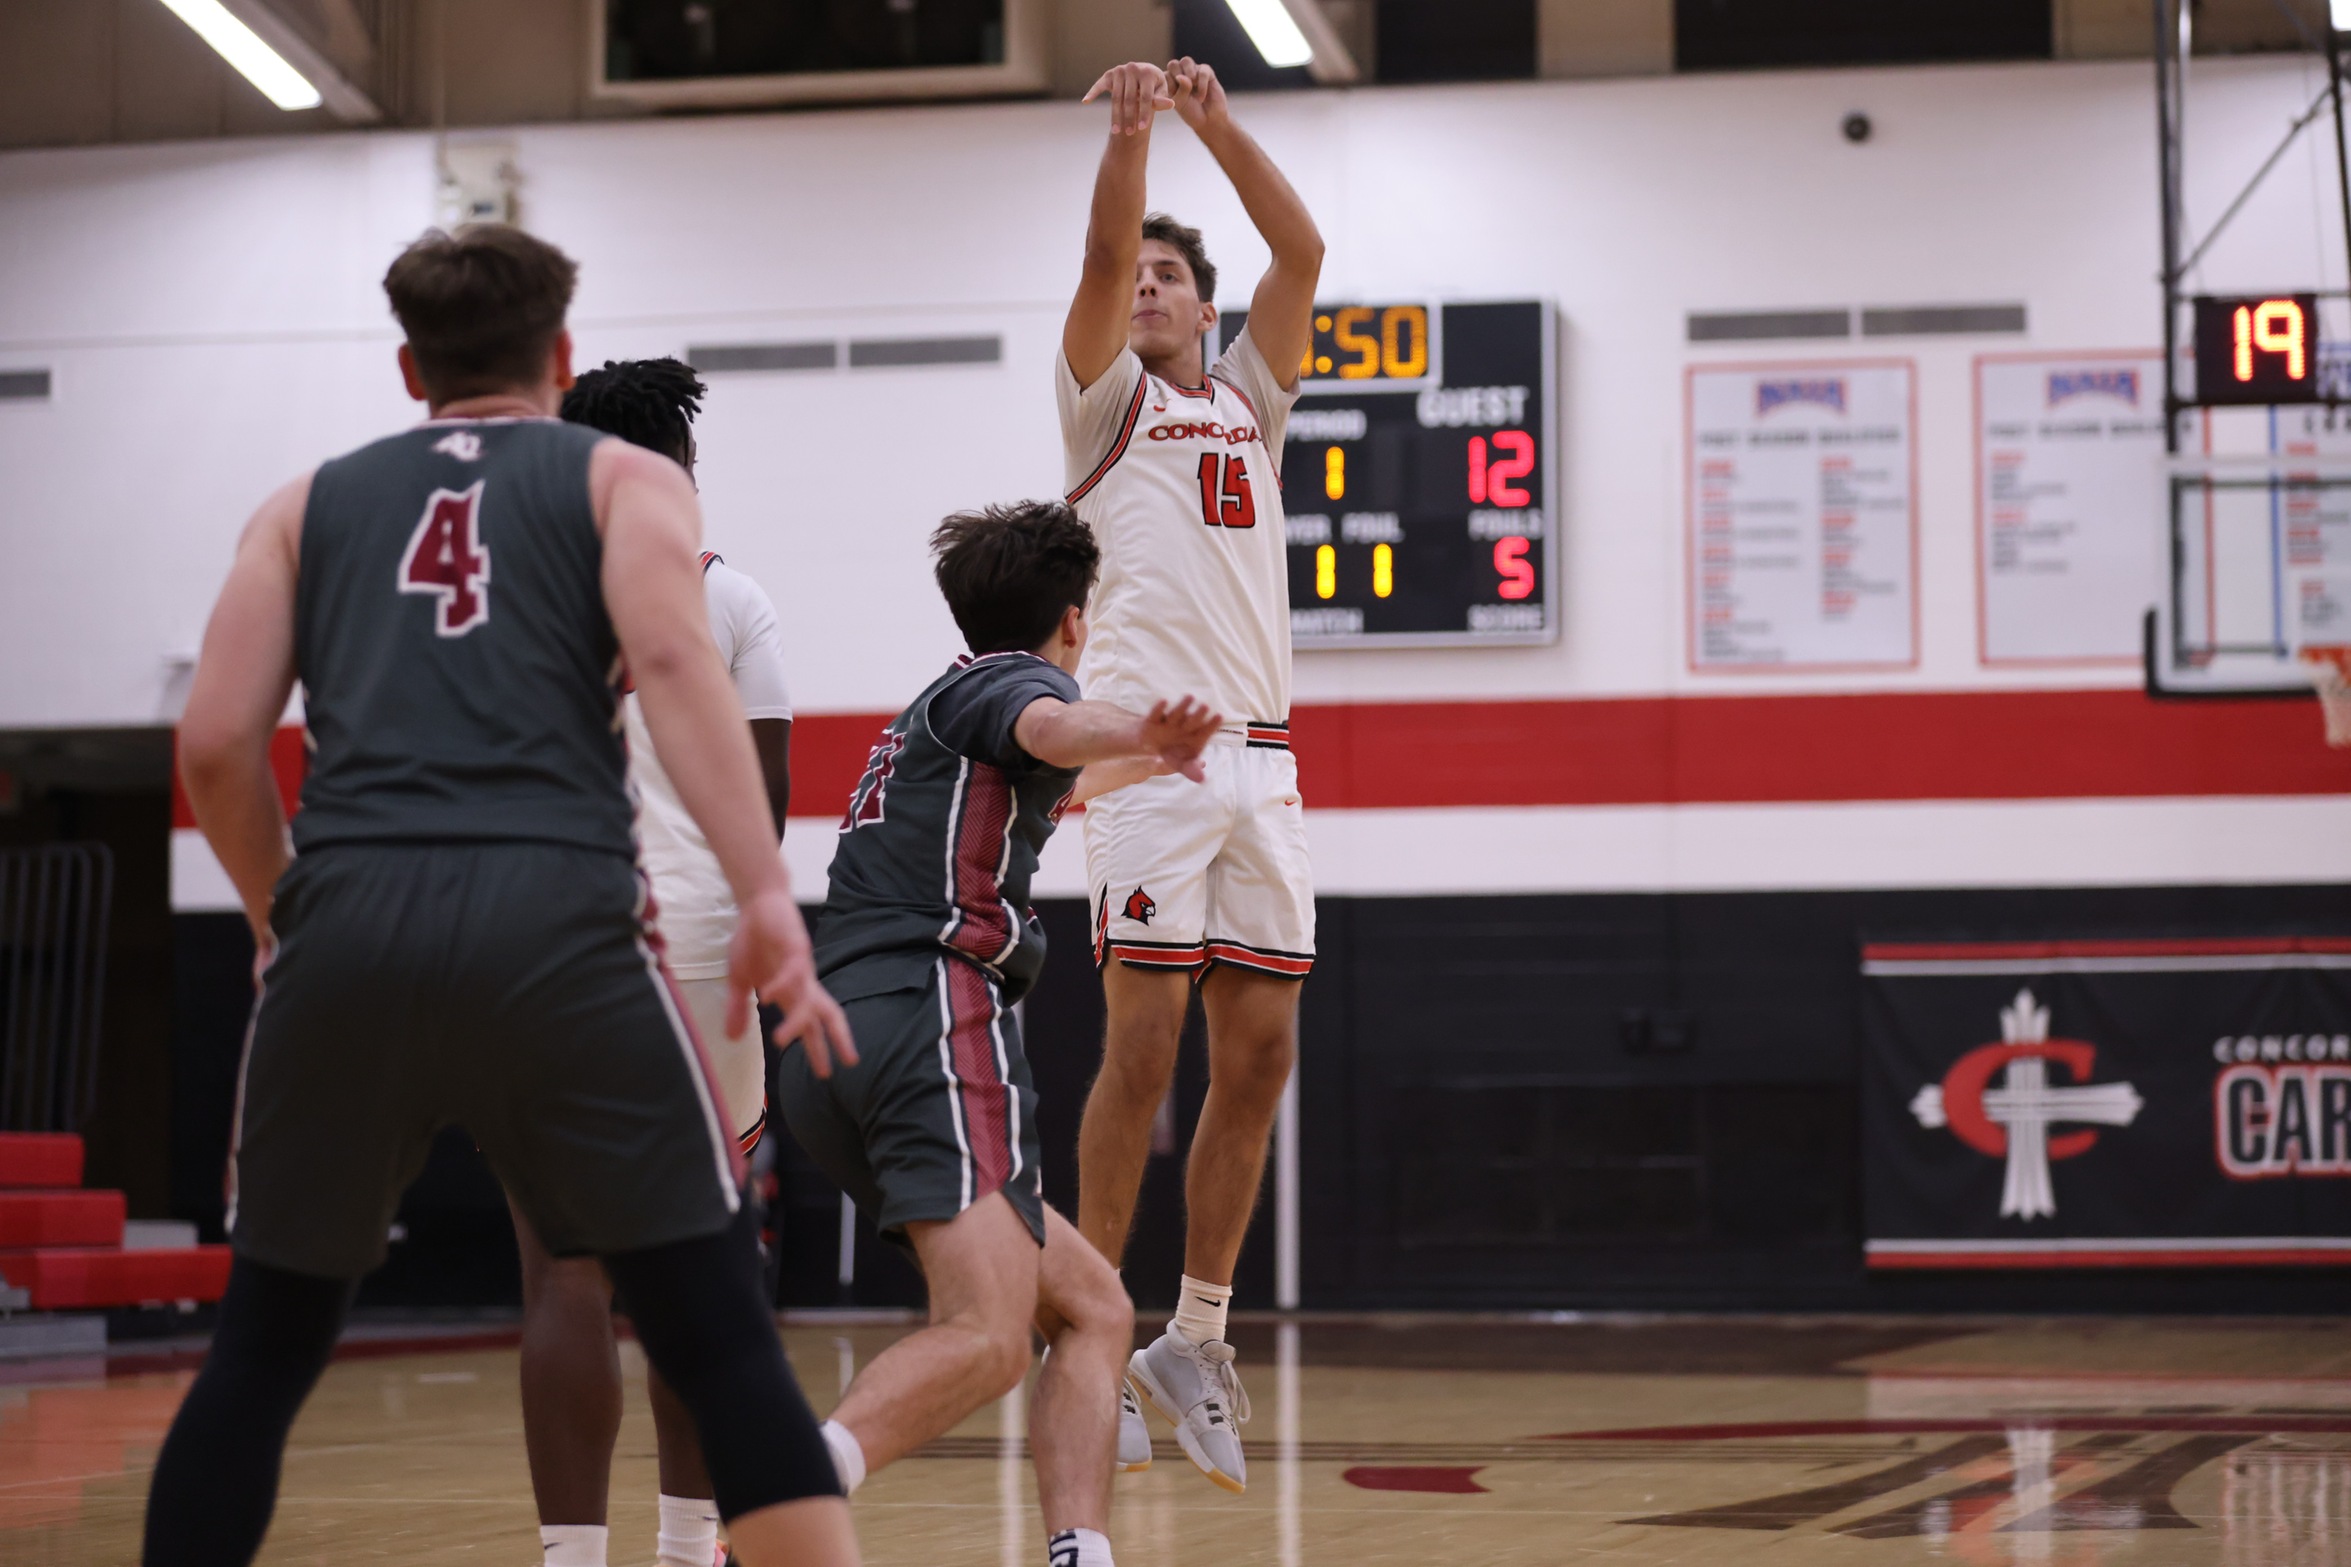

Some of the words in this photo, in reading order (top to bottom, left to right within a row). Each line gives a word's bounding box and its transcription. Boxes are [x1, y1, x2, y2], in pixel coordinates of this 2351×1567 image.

[1300, 305, 1429, 380] :50
[2233, 299, 2305, 382] 19
[1416, 386, 1529, 427] GUEST
[1197, 452, 1256, 529] 15
[1326, 446, 1344, 500] 1
[1468, 430, 1535, 507] 12
[397, 479, 491, 638] 4
[1494, 536, 1535, 599] 5
